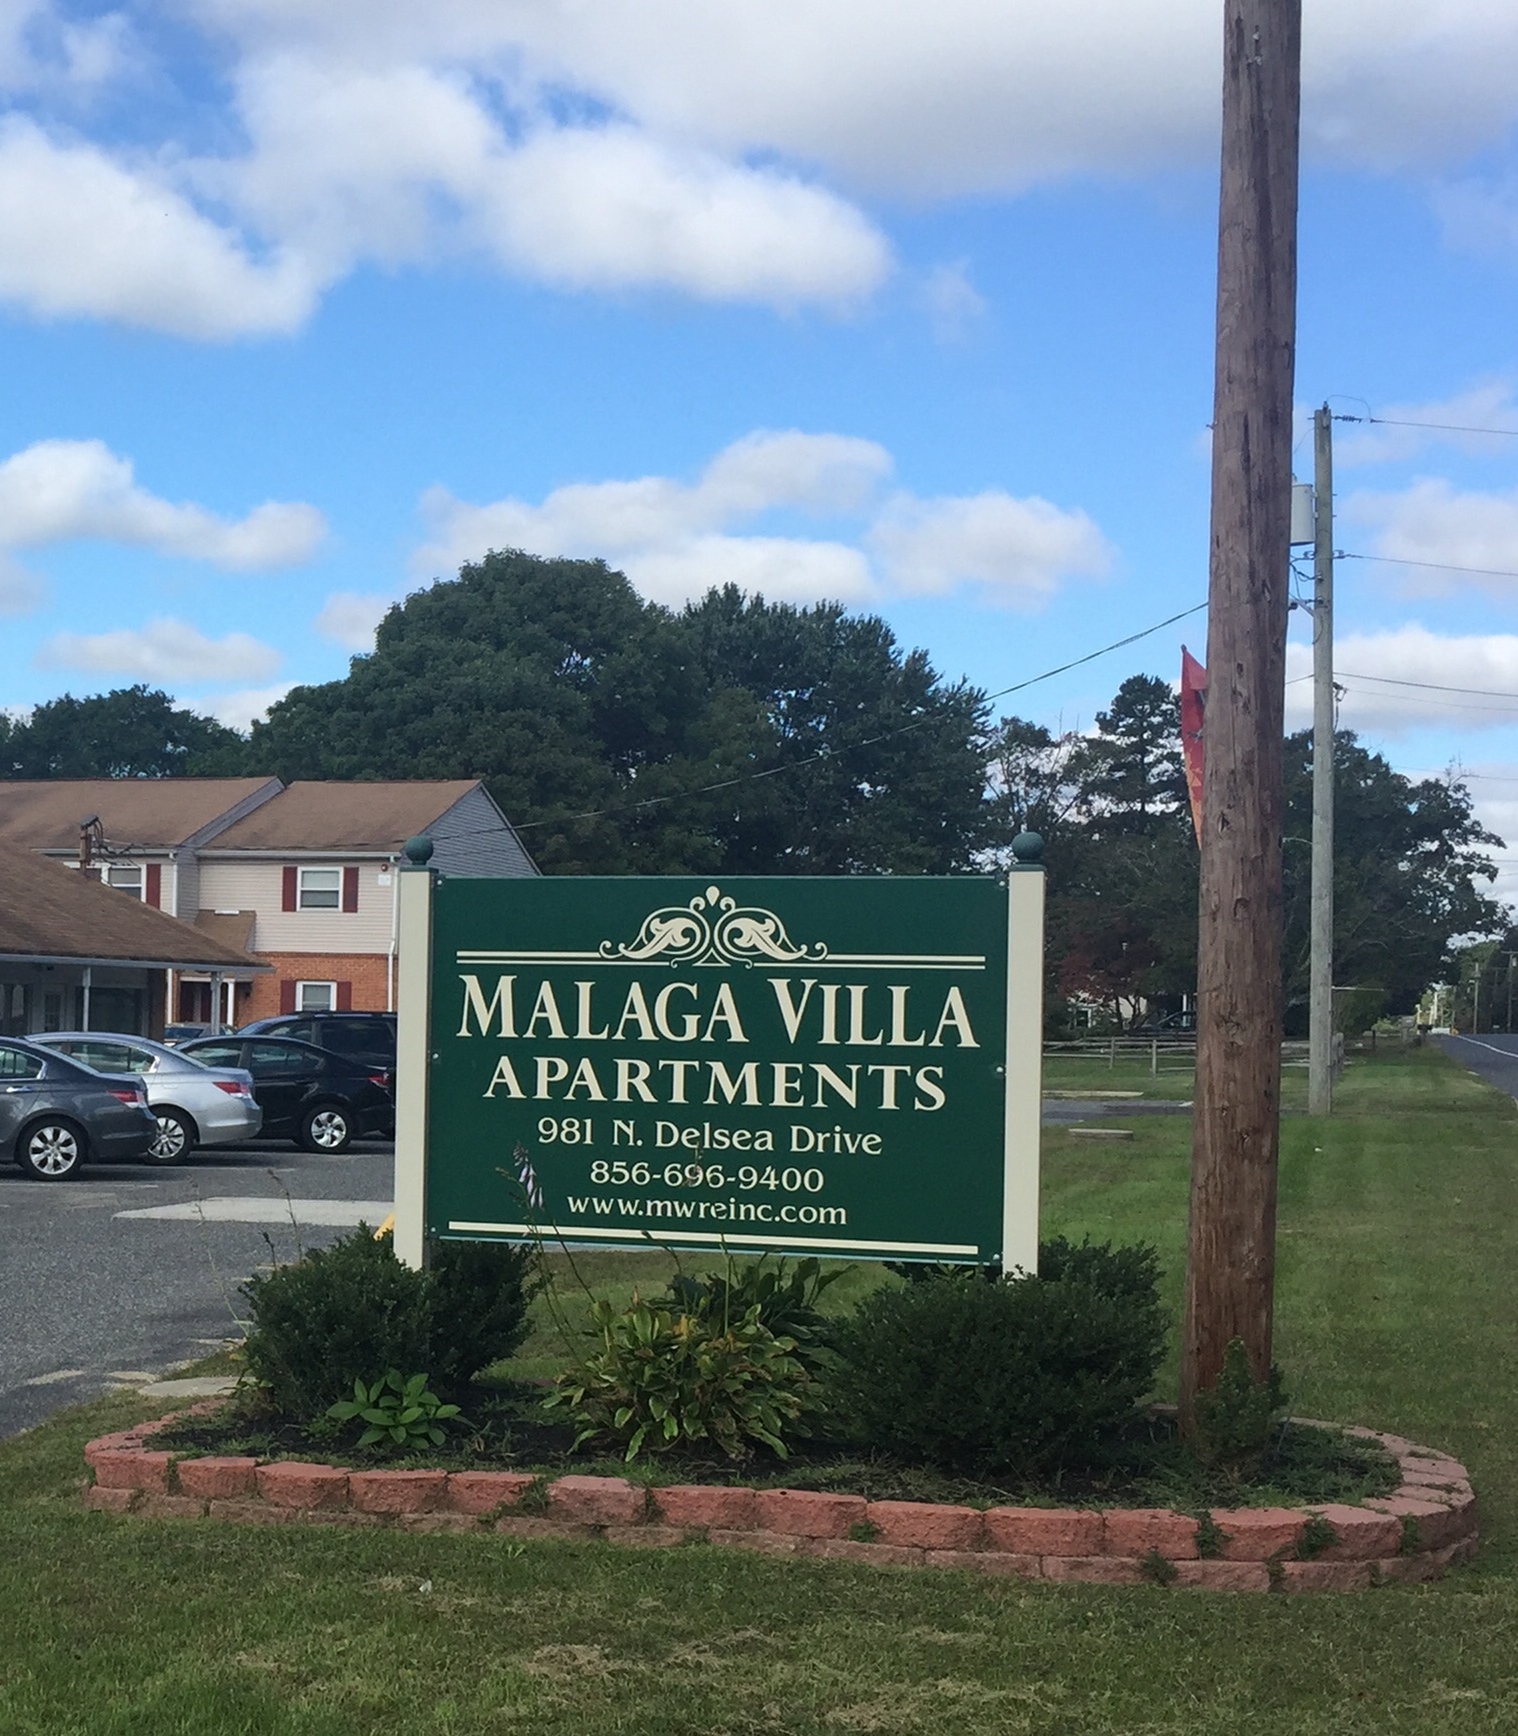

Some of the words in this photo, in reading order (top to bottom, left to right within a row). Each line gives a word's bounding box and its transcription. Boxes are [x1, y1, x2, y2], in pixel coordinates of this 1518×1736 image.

[456, 974, 750, 1043] MALAGA
[767, 978, 981, 1048] VILLA
[482, 1055, 946, 1111] APARTMENTS
[537, 1117, 594, 1145] 981
[612, 1119, 643, 1147] N.
[655, 1121, 774, 1152] Delsea
[790, 1125, 882, 1155] Drive
[590, 1160, 824, 1192] 856-696-9400
[567, 1196, 847, 1225] www.mwreinc.com
